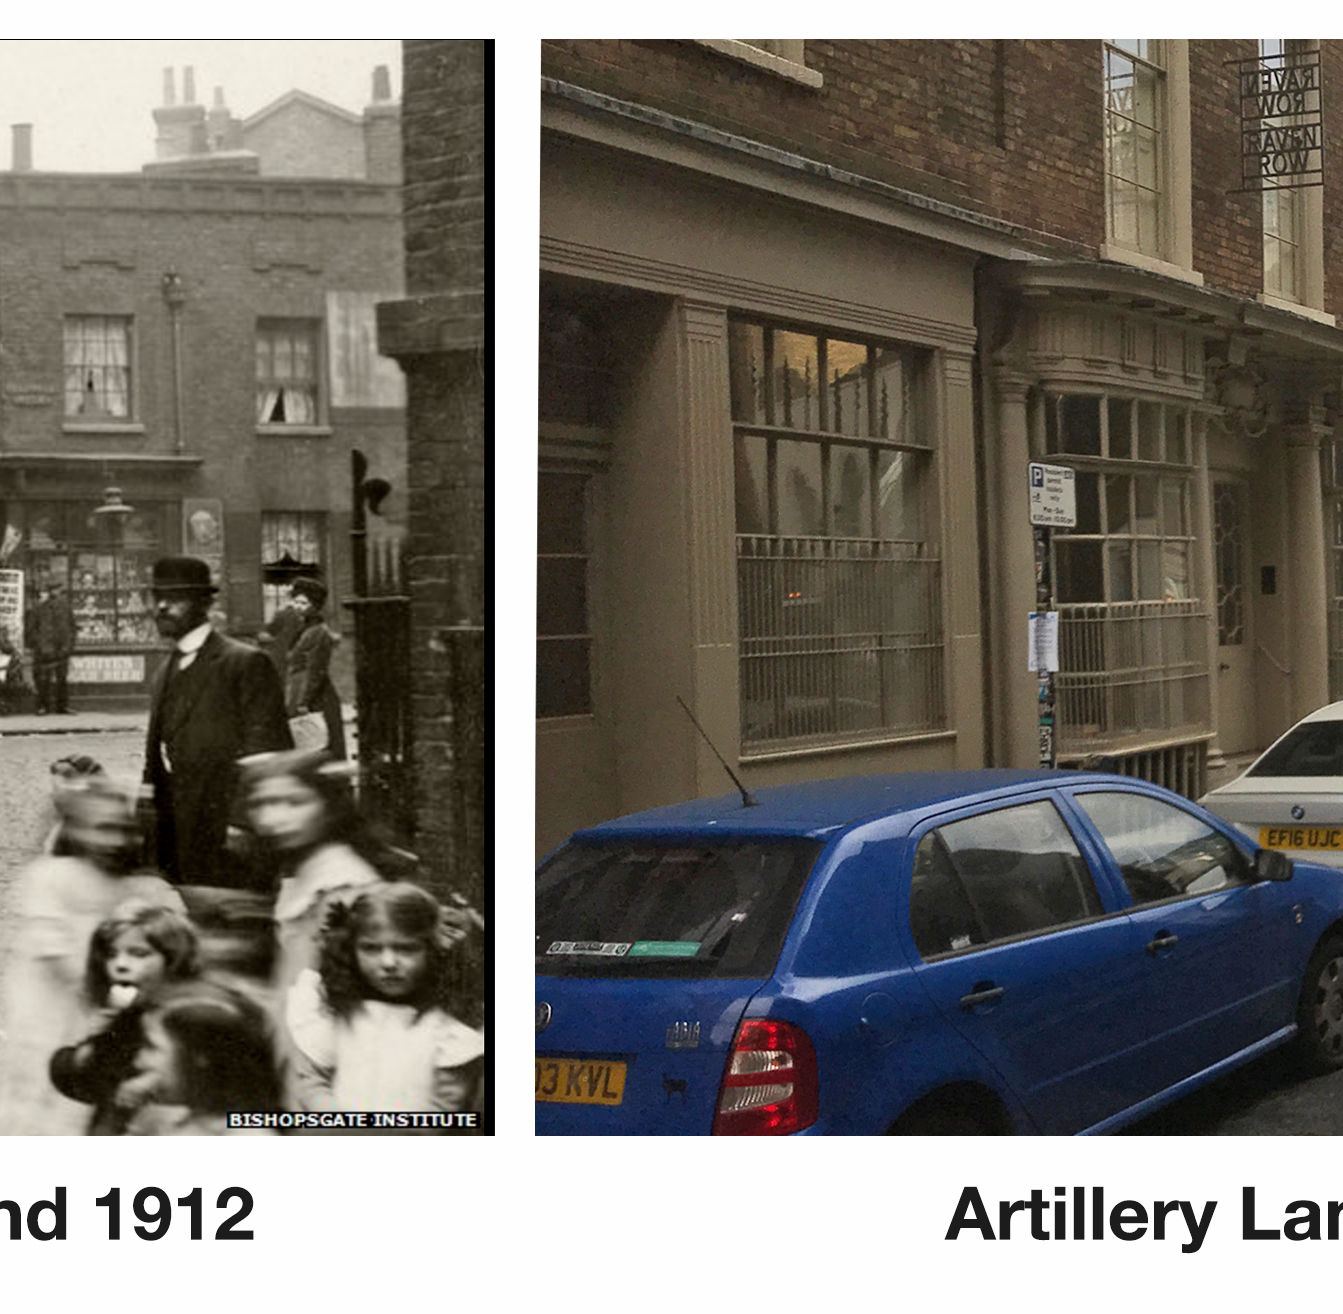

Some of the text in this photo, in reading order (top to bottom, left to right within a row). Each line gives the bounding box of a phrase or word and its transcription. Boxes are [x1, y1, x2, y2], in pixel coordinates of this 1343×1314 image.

[1244, 126, 1316, 154] RAVEN
[1259, 151, 1308, 174] ROW
[1267, 829, 1341, 848] EF16 UJC
[564, 1062, 618, 1099] KVL
